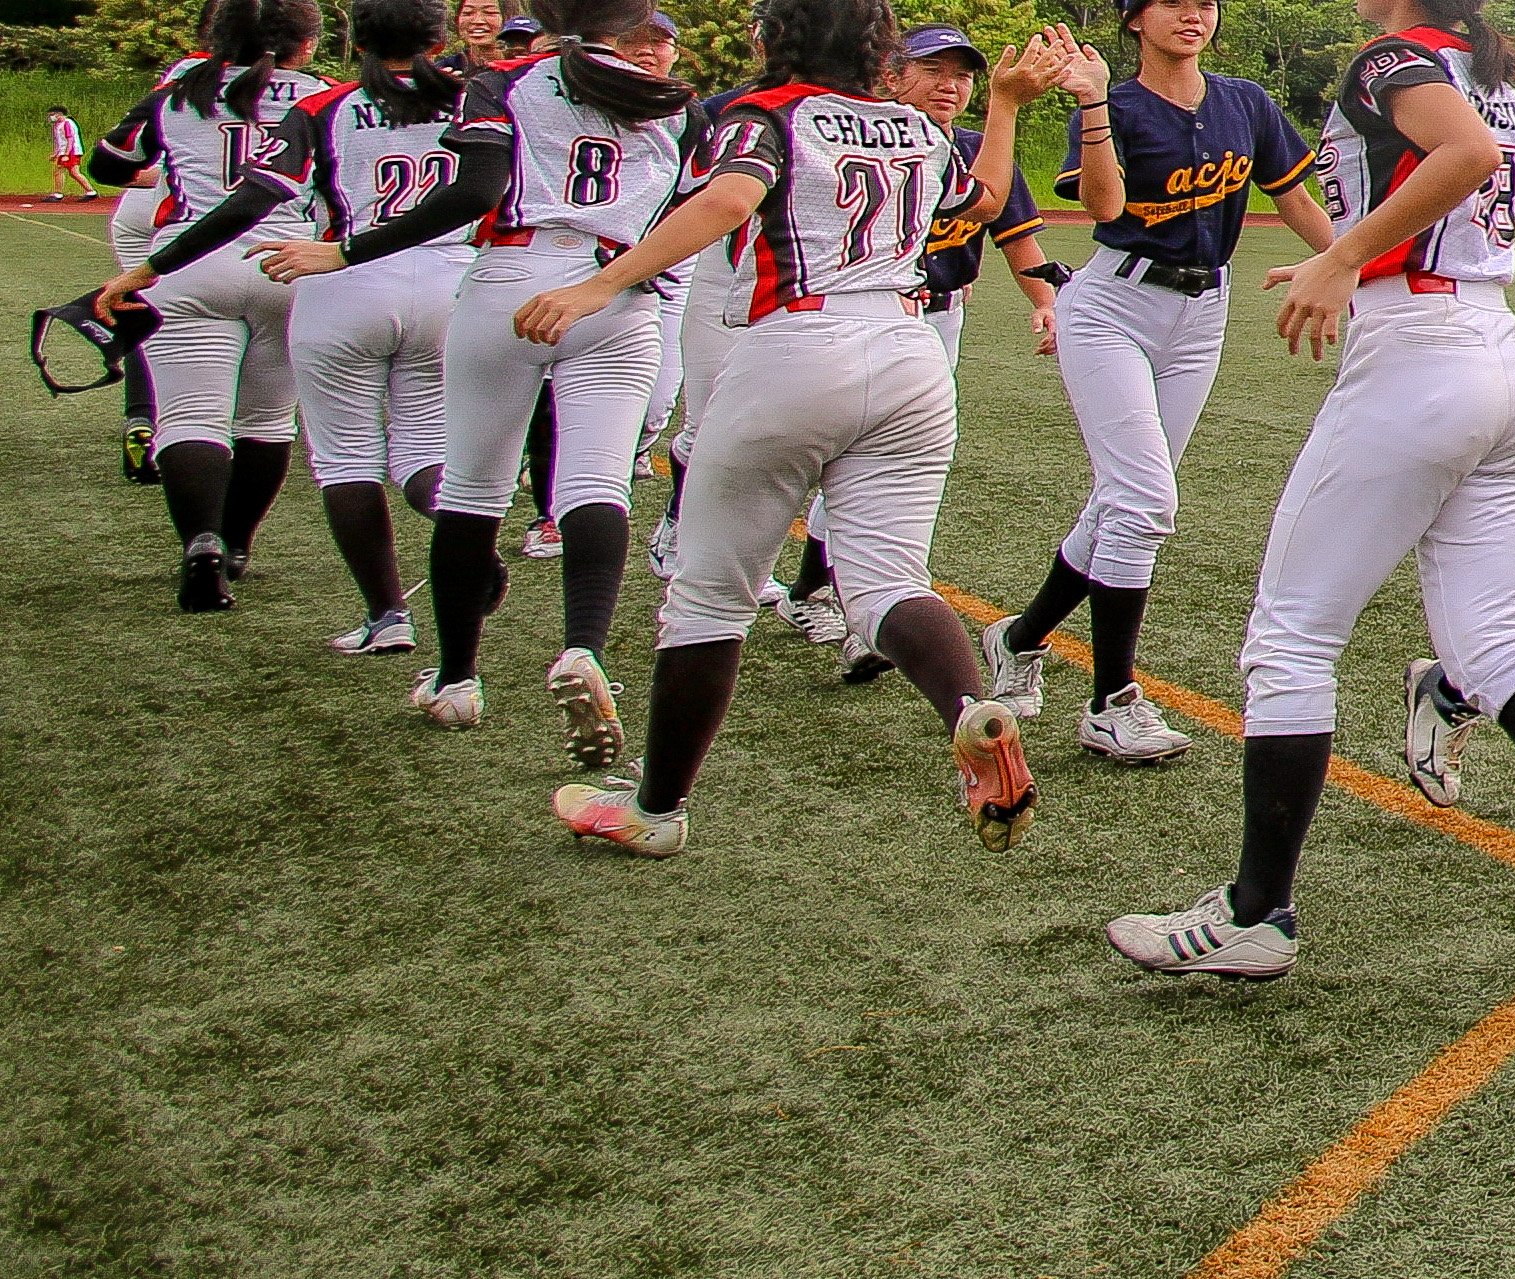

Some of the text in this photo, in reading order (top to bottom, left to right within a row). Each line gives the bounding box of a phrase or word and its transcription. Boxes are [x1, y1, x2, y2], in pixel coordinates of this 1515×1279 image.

[812, 114, 917, 149] CHLOE
[370, 150, 460, 227] 22
[563, 134, 622, 209] 8
[1165, 150, 1253, 198] acjc
